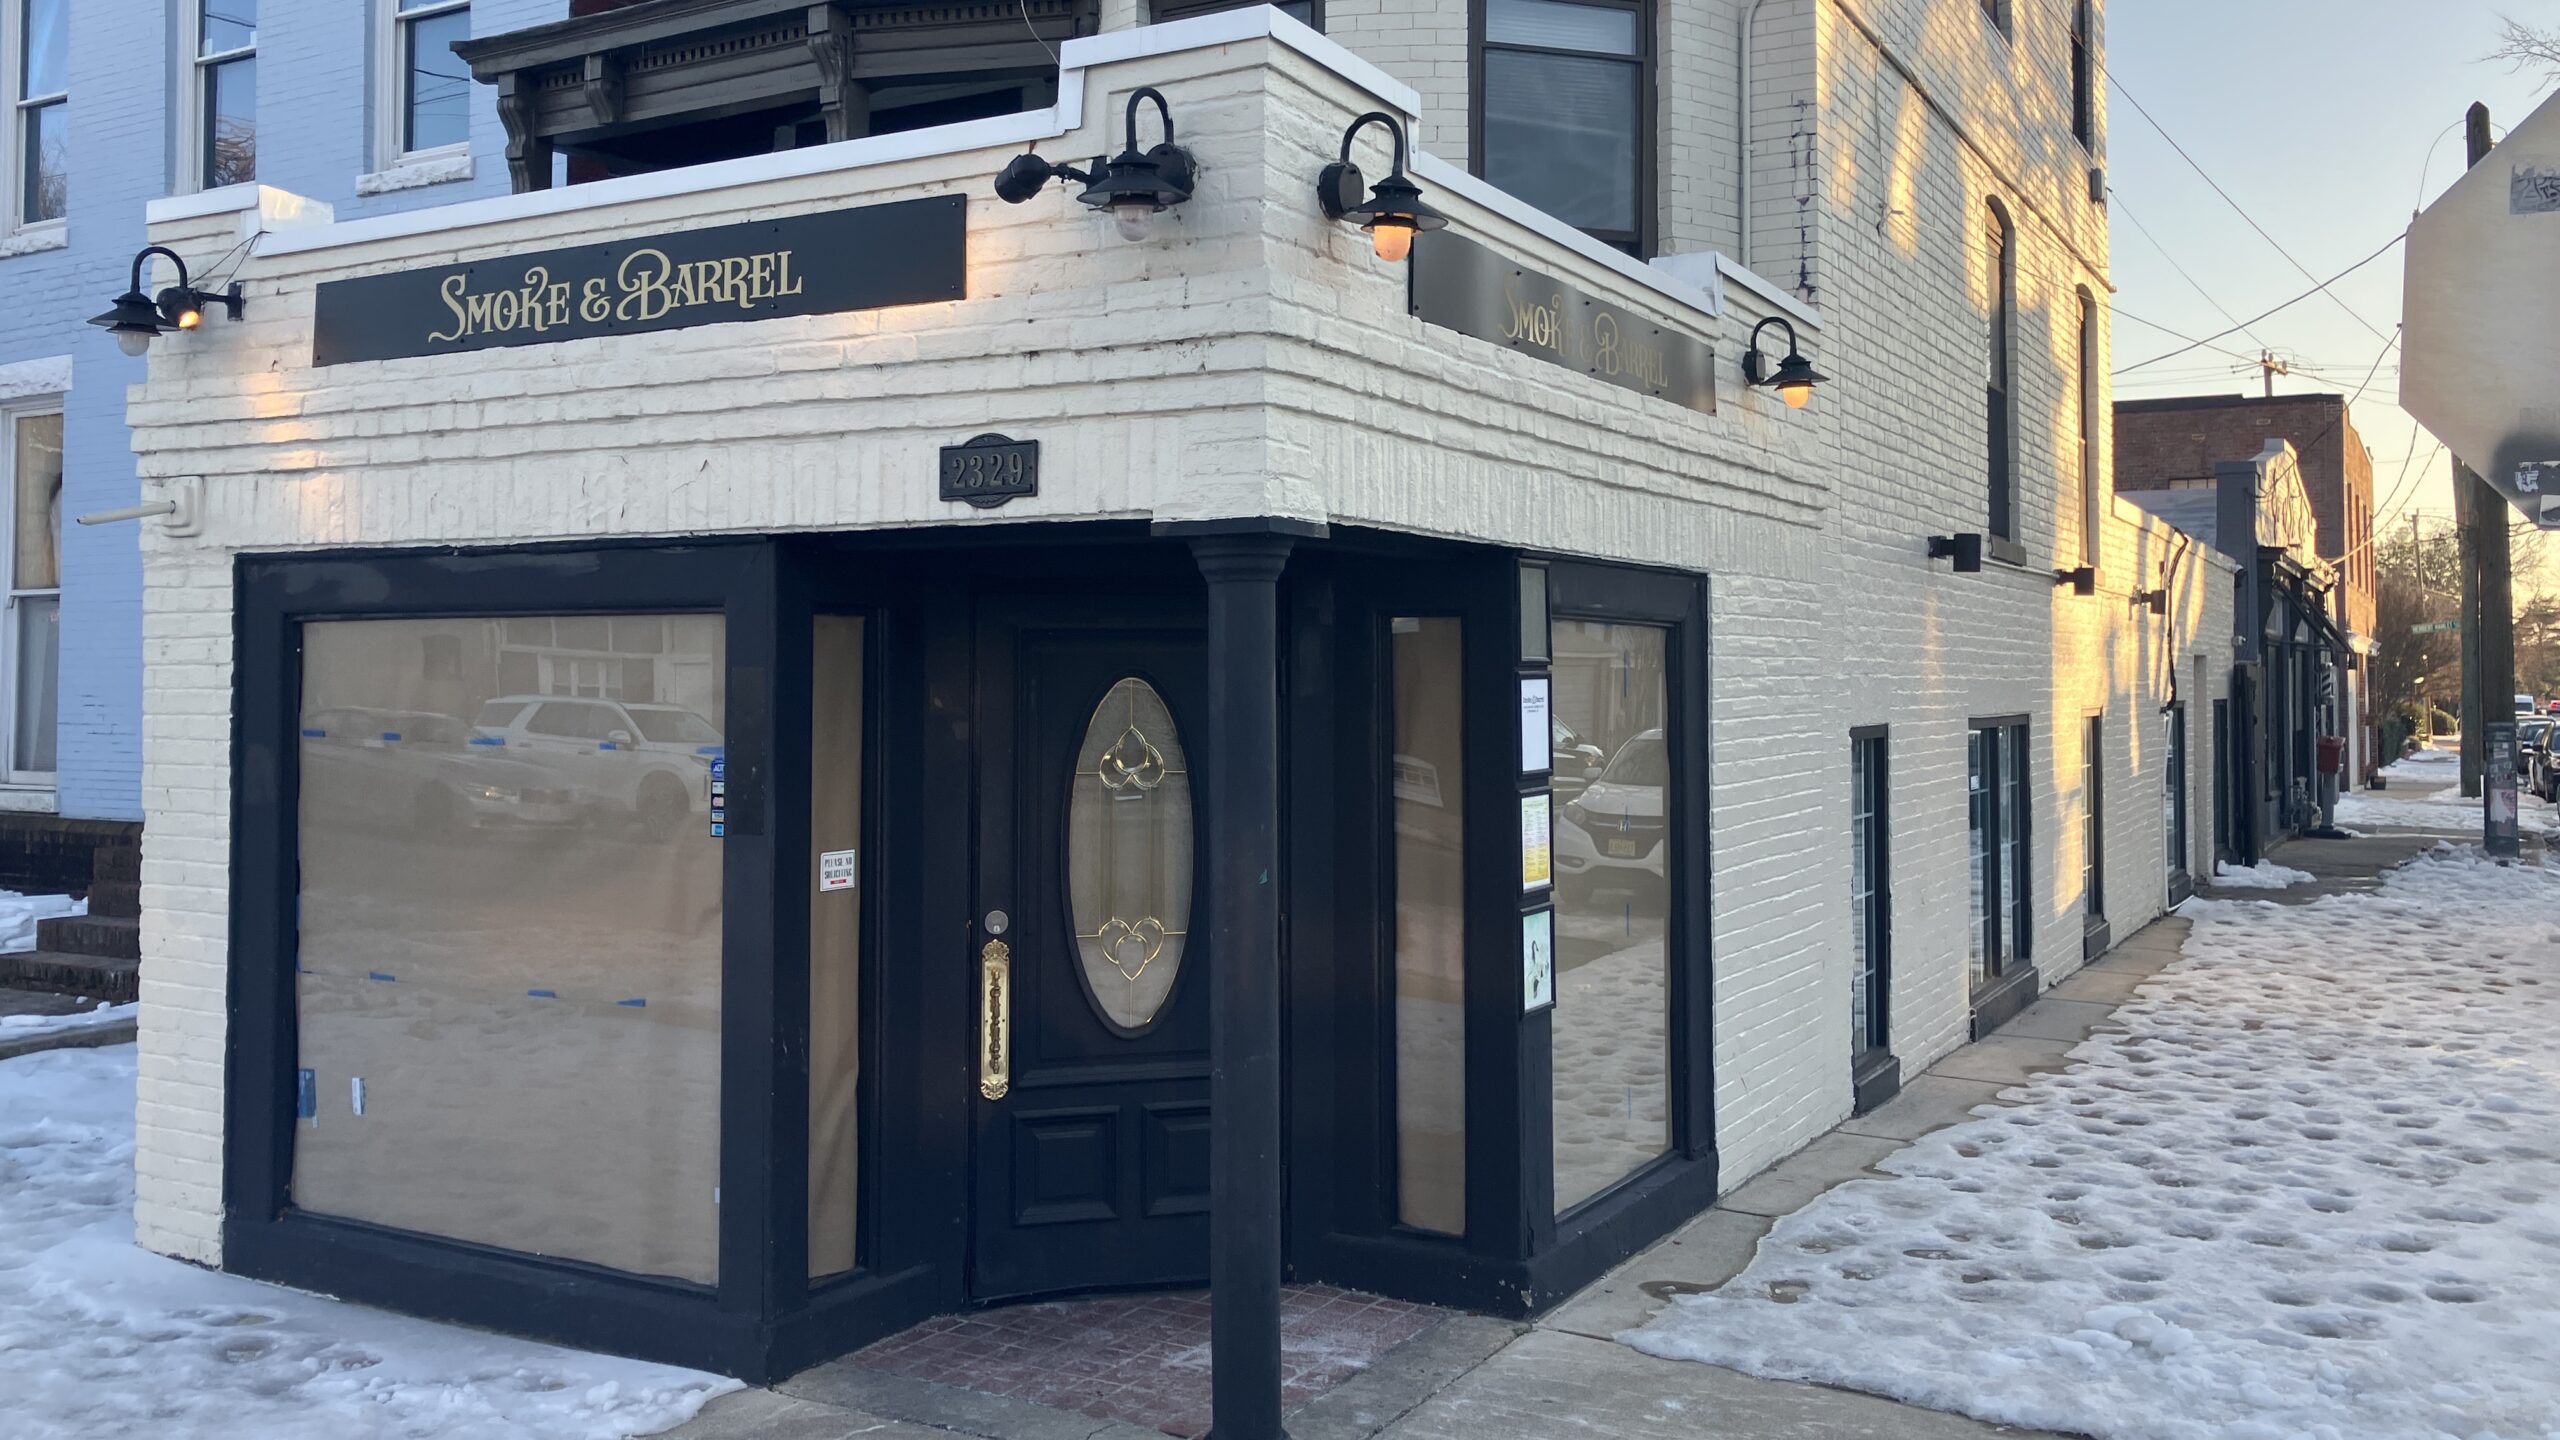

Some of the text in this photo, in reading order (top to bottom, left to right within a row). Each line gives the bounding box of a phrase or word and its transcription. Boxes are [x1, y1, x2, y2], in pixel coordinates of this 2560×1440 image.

[428, 249, 802, 344] SMOKE & BARREL
[1595, 312, 1668, 389] BARREL
[953, 452, 1024, 489] 2329
[824, 868, 852, 879] SOLICITING
[825, 857, 852, 868] PLEASE NO
